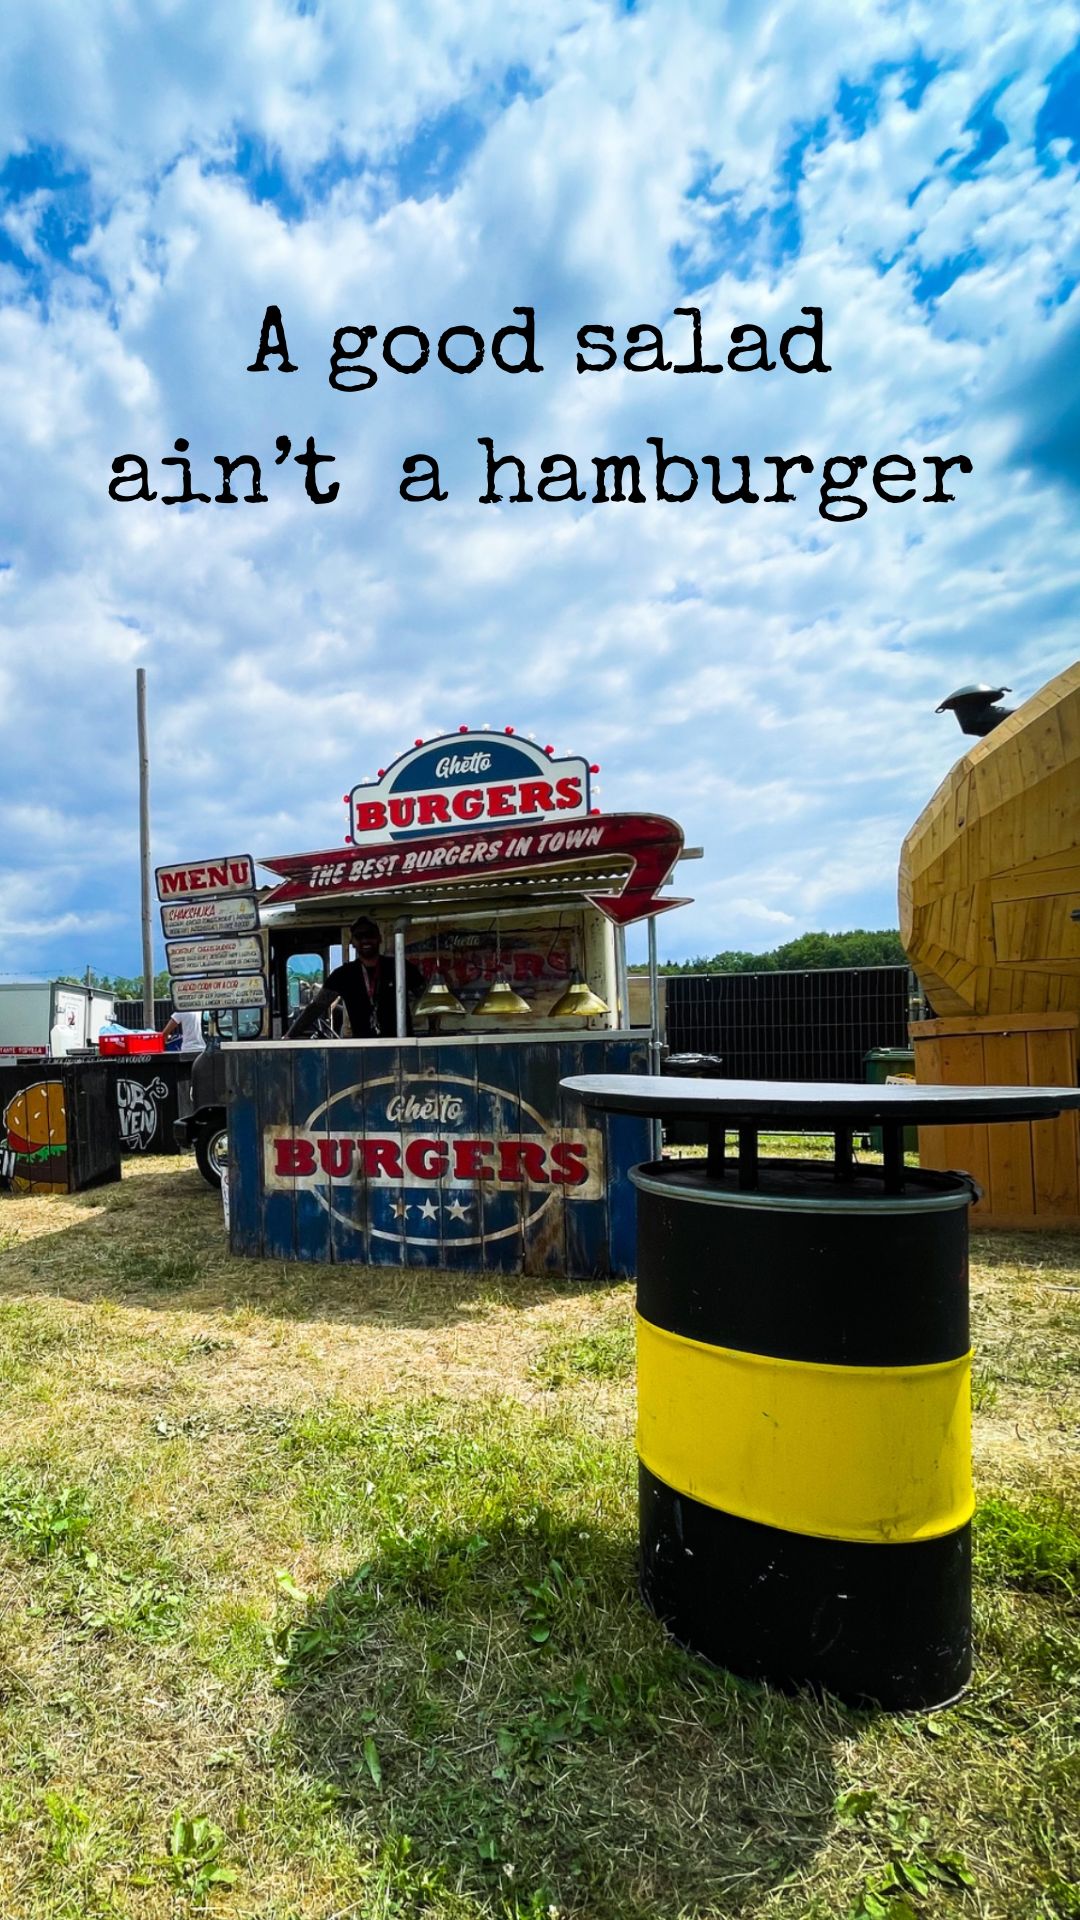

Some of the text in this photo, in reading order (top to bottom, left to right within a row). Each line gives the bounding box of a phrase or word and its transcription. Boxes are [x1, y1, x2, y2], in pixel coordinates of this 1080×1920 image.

[435, 751, 492, 779] Ghetto
[356, 776, 583, 831] BURGERS
[309, 826, 605, 888] THE BEST BURGERS IN TOWN
[160, 863, 249, 894] MENU
[386, 1095, 464, 1124] Ghetto
[274, 1137, 590, 1185] BURGERS
